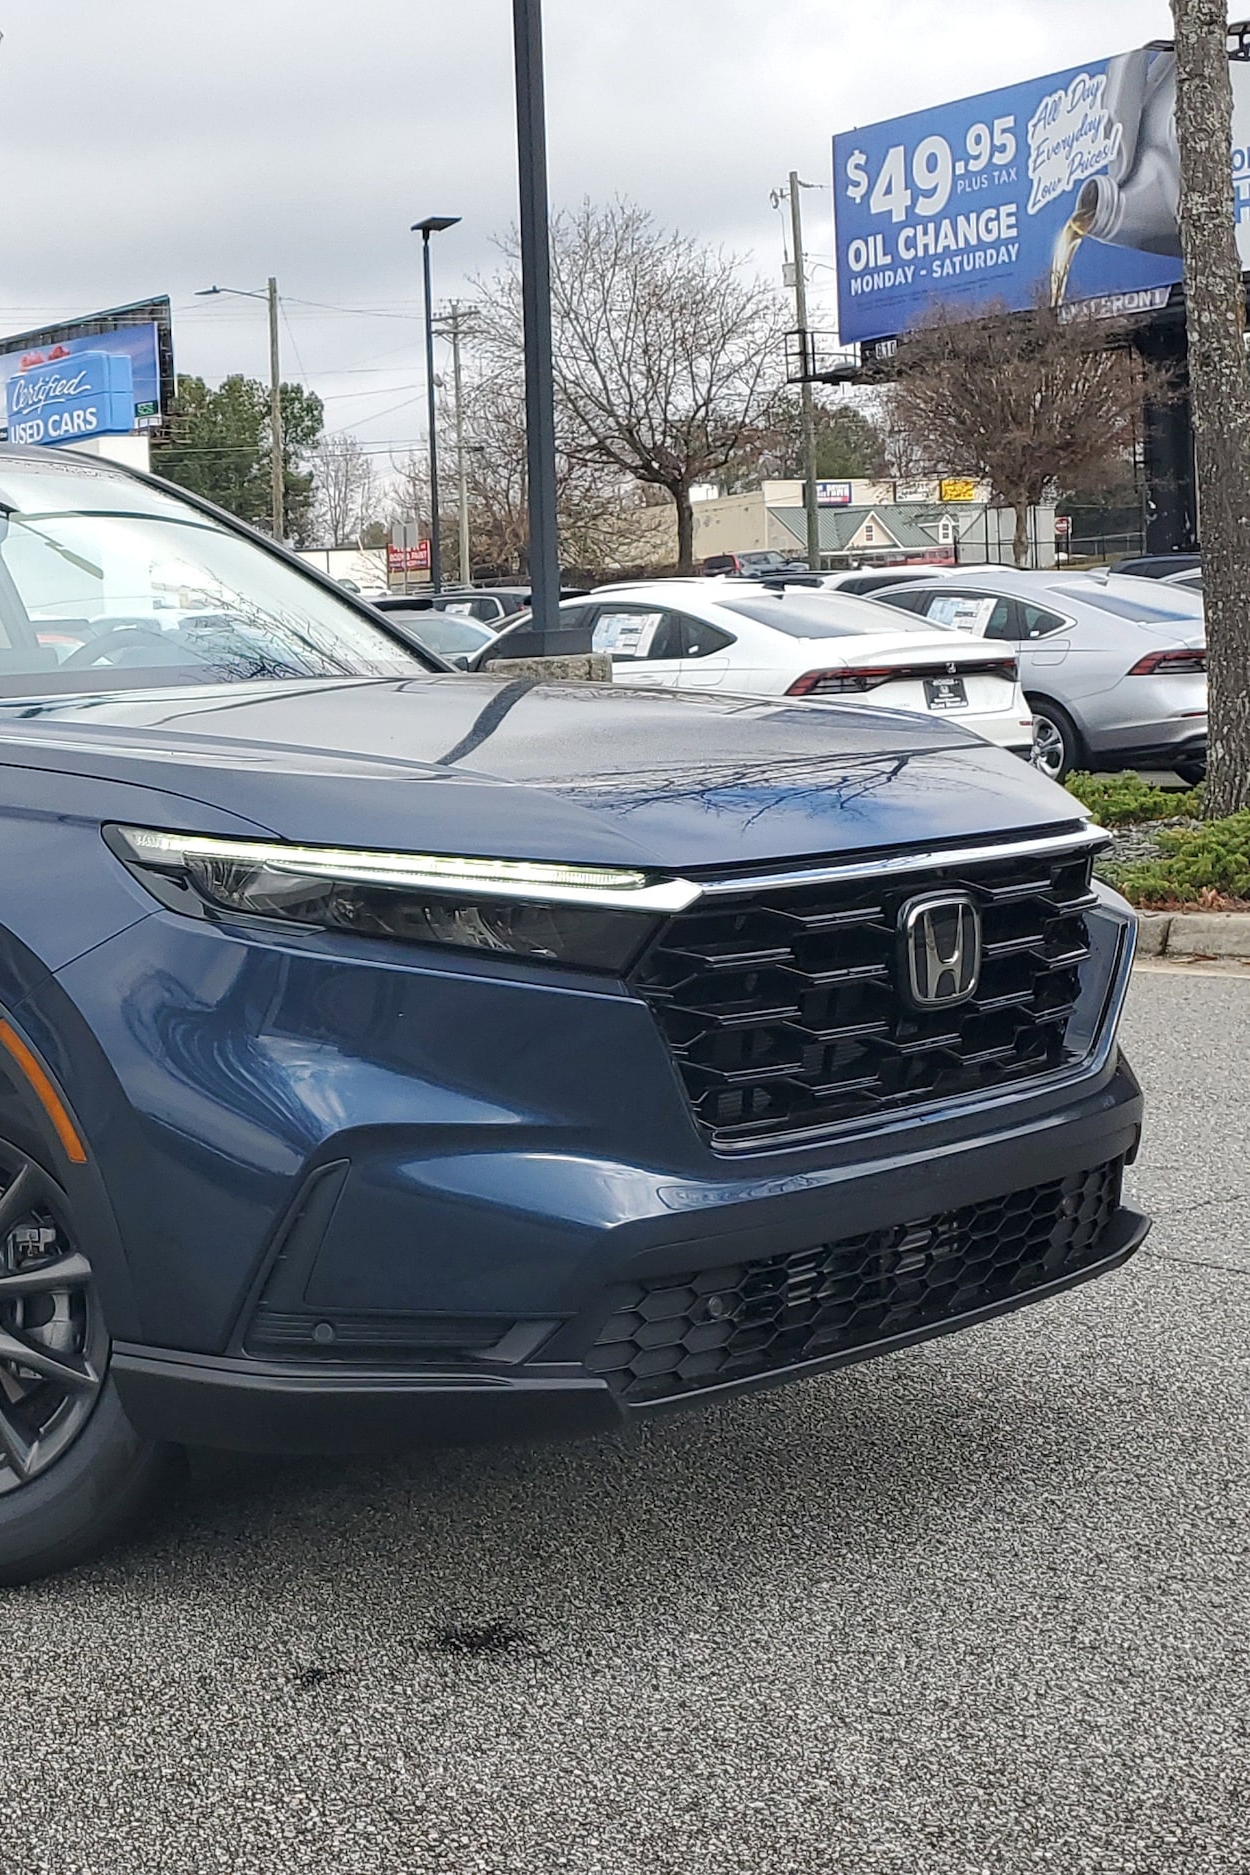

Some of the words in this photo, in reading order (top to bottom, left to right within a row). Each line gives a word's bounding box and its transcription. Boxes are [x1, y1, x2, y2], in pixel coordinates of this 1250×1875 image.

[1031, 95, 1062, 139] All
[1066, 79, 1104, 113] Day
[846, 115, 1017, 223] $49.95
[1031, 176, 1063, 209] Low
[1067, 127, 1119, 185] Prices!
[1032, 112, 1105, 173] Everyday
[957, 174, 989, 195] PLUS
[993, 167, 1018, 186] TAX
[848, 233, 892, 272] OIL
[898, 203, 1018, 260] CHANGE
[851, 265, 915, 296] MONDAY
[932, 243, 1019, 278] SATURDAY
[12, 370, 91, 415] Certified
[10, 420, 45, 445] USED
[48, 407, 98, 438] CARS
